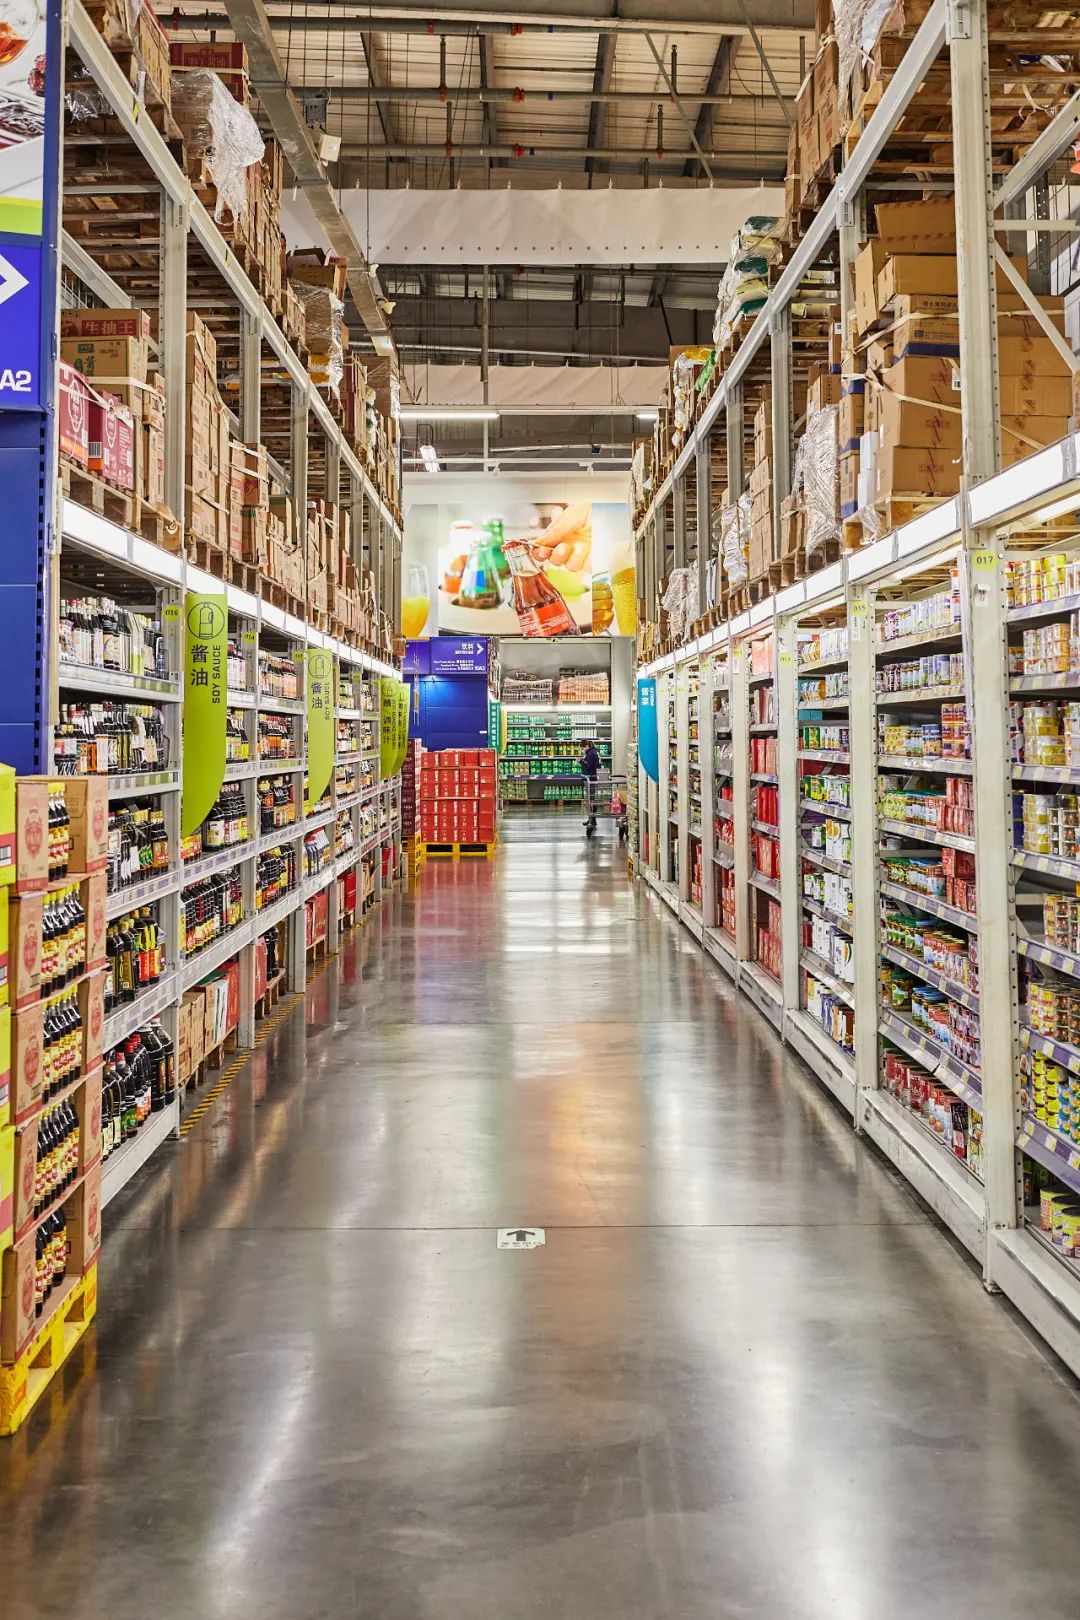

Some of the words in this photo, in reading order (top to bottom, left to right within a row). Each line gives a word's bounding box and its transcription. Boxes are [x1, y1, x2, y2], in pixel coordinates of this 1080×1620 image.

[84, 320, 134, 335] 生抽王
[0, 368, 32, 392] A2
[976, 556, 993, 564] 017
[191, 644, 209, 687] 酱油
[211, 644, 221, 680] SAUCE
[211, 683, 221, 704] SOY
[311, 682, 323, 709] 酱油
